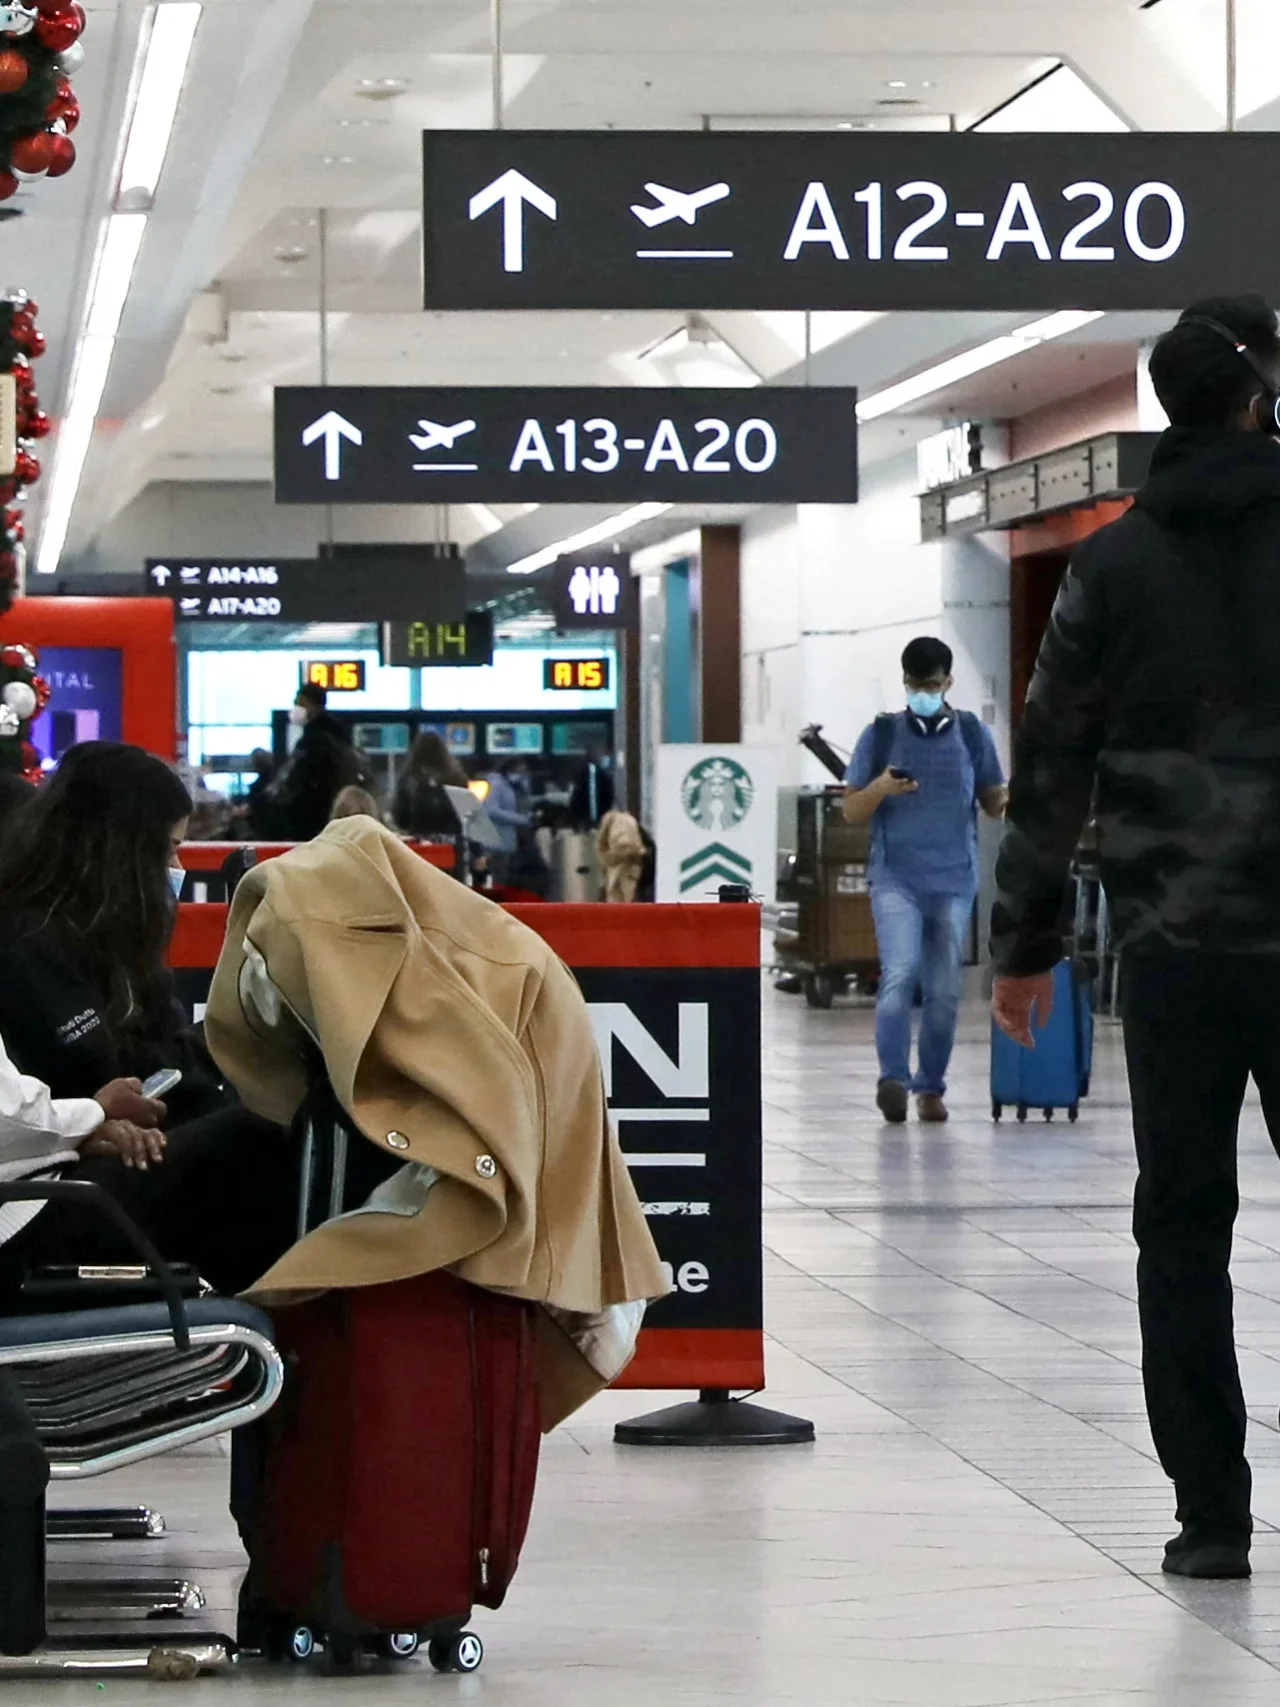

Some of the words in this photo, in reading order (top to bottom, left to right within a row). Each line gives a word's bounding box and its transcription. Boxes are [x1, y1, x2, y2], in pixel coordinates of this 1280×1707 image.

[783, 181, 1186, 262] A12-A20
[509, 418, 778, 473] A13-A20
[207, 566, 279, 585] A14-A16
[207, 597, 281, 616] A17-A20
